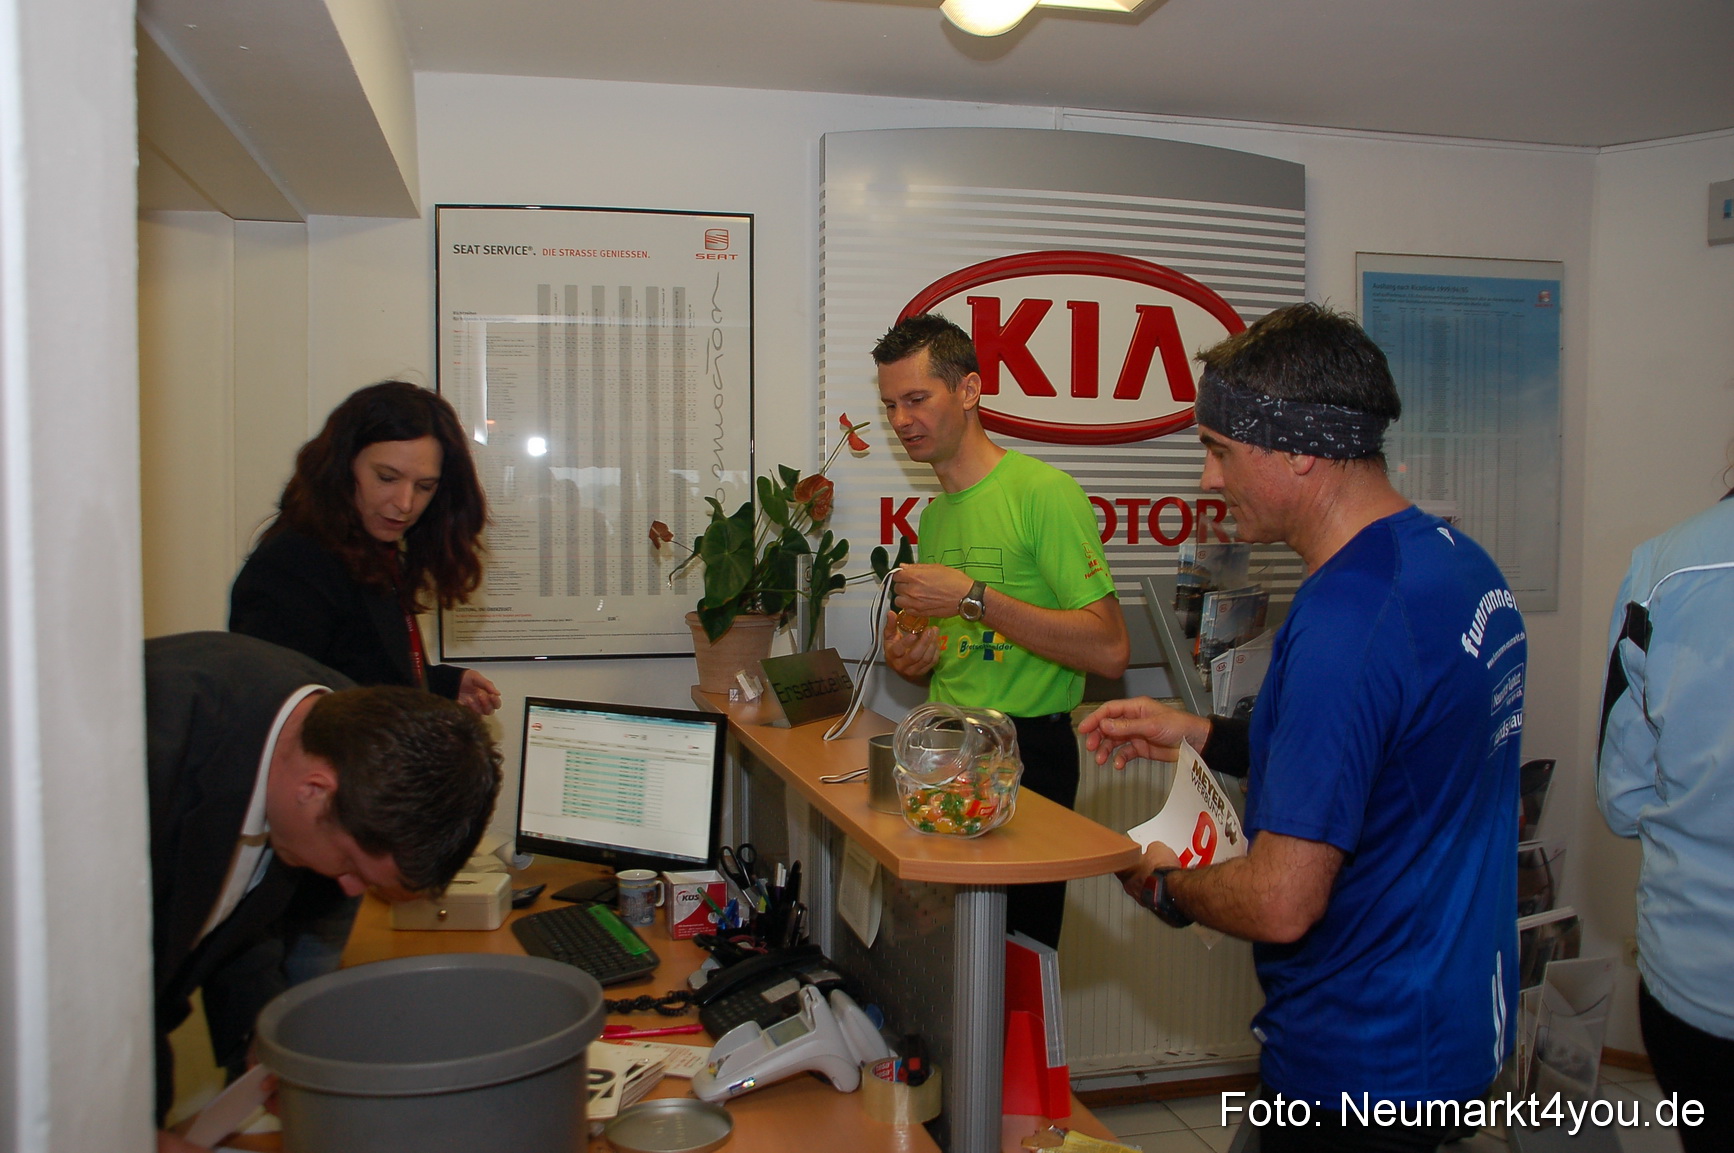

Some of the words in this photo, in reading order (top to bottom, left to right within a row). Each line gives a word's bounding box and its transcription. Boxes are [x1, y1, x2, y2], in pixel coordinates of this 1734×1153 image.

[453, 244, 480, 255] SEAT
[542, 248, 557, 256] DIE
[559, 249, 598, 258] STRASSE
[600, 250, 650, 259] GENIESSEN.
[967, 296, 1198, 402] KIA
[772, 671, 852, 704] Ersatzteile
[1192, 759, 1226, 815] MEYER
